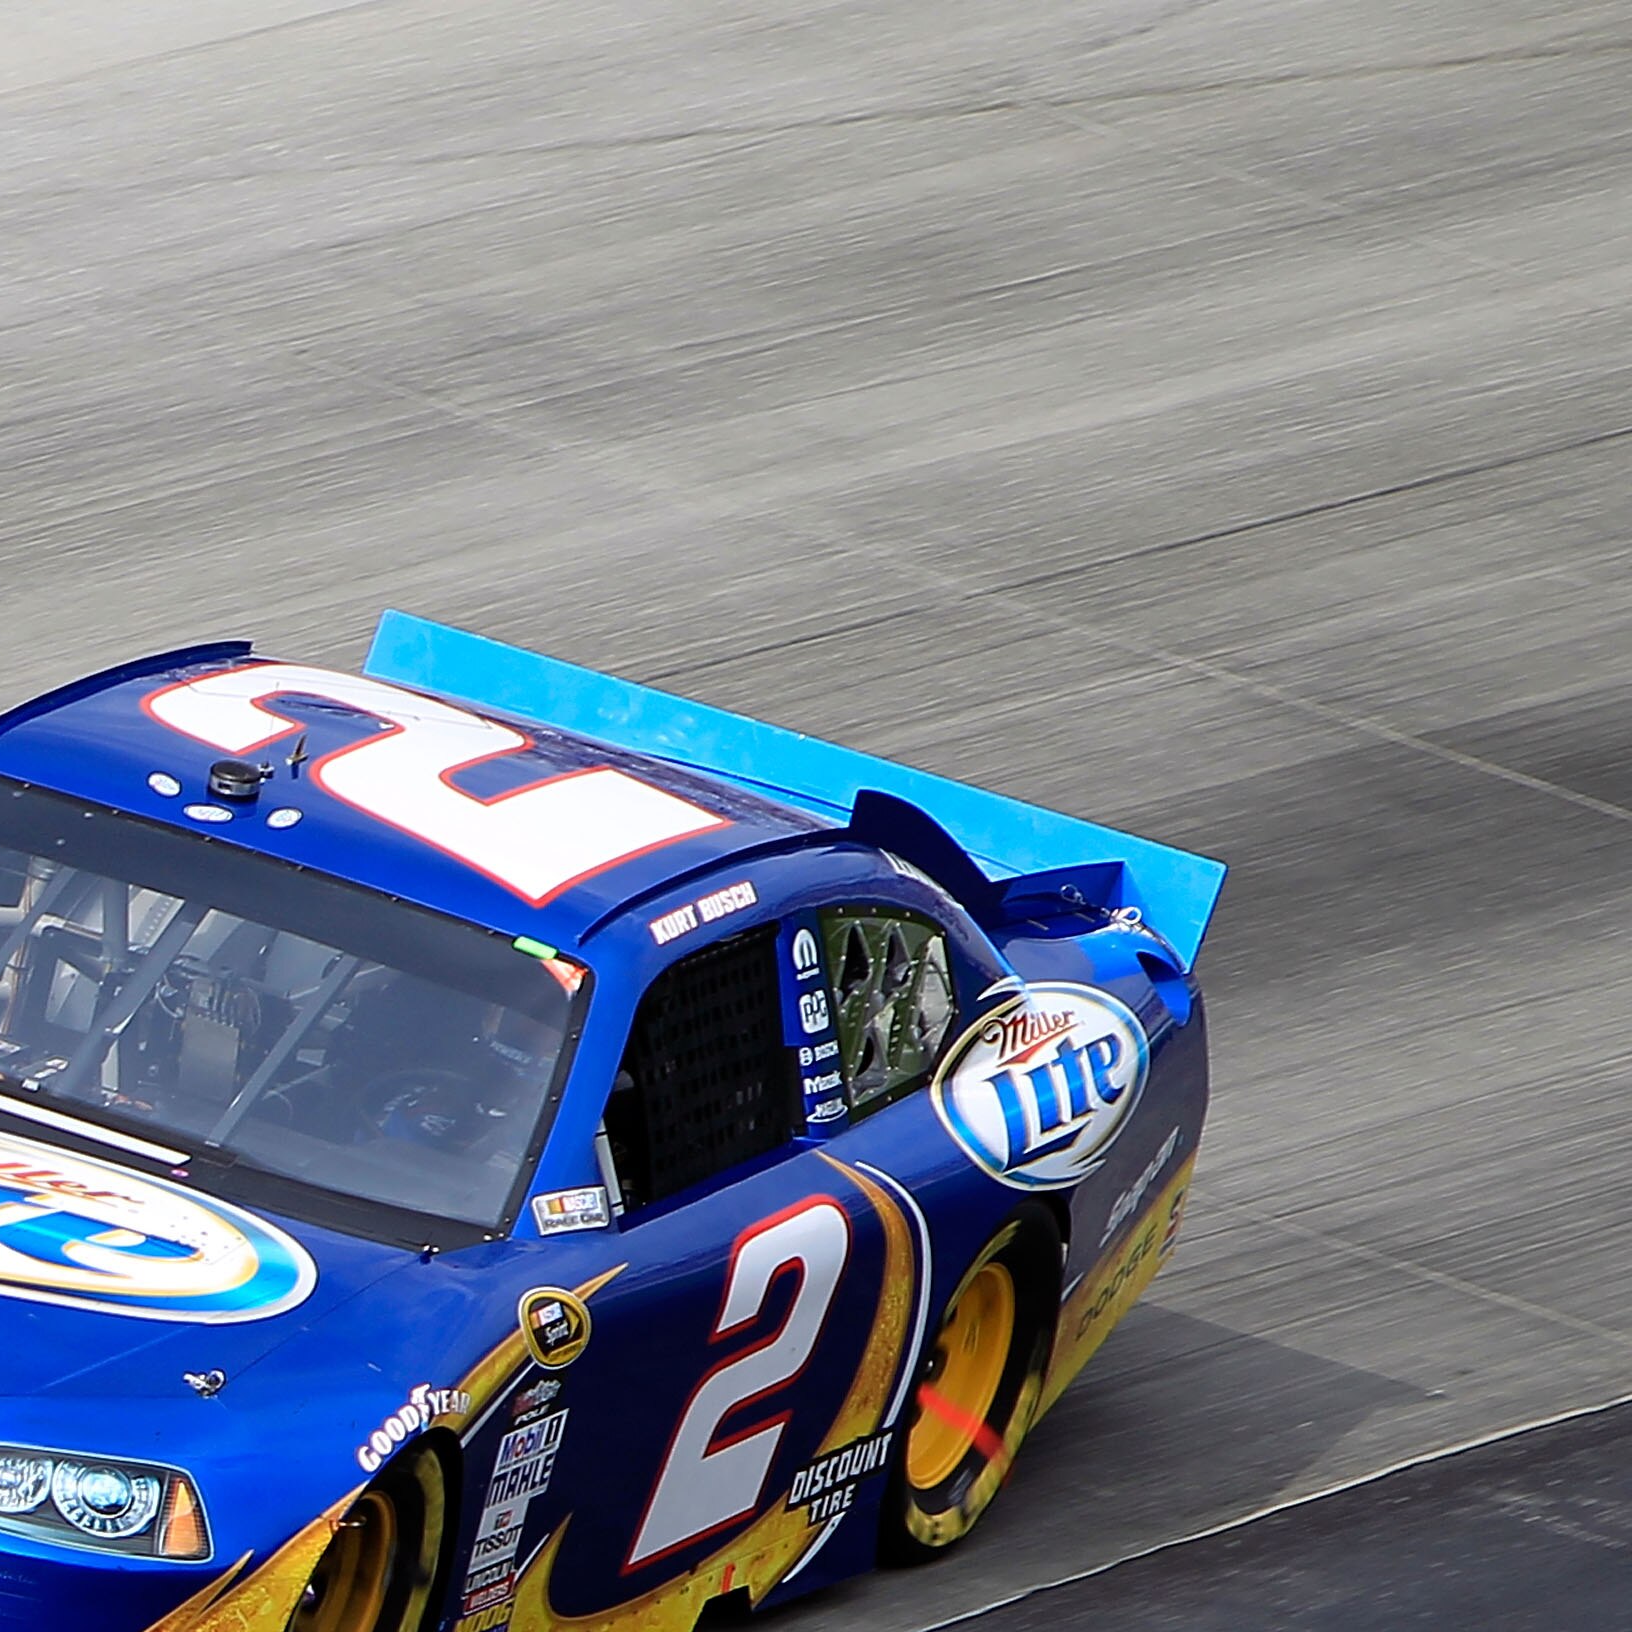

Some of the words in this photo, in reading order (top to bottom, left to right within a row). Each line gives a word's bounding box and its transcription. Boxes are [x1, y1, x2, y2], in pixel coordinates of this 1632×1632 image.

[140, 661, 736, 910] 2
[649, 904, 699, 944] KURT
[697, 880, 757, 922] BUSCH
[982, 1009, 1077, 1060] Miller
[981, 1031, 1128, 1173] Lite
[618, 1194, 854, 1578] 2
[357, 1383, 472, 1474] GOODYEAR
[499, 1420, 547, 1465] Mobil
[486, 1453, 555, 1508] MAHLE
[789, 1433, 894, 1506] DISCOUNT
[809, 1483, 856, 1523] TIRE
[473, 1523, 524, 1558] TISSOT
